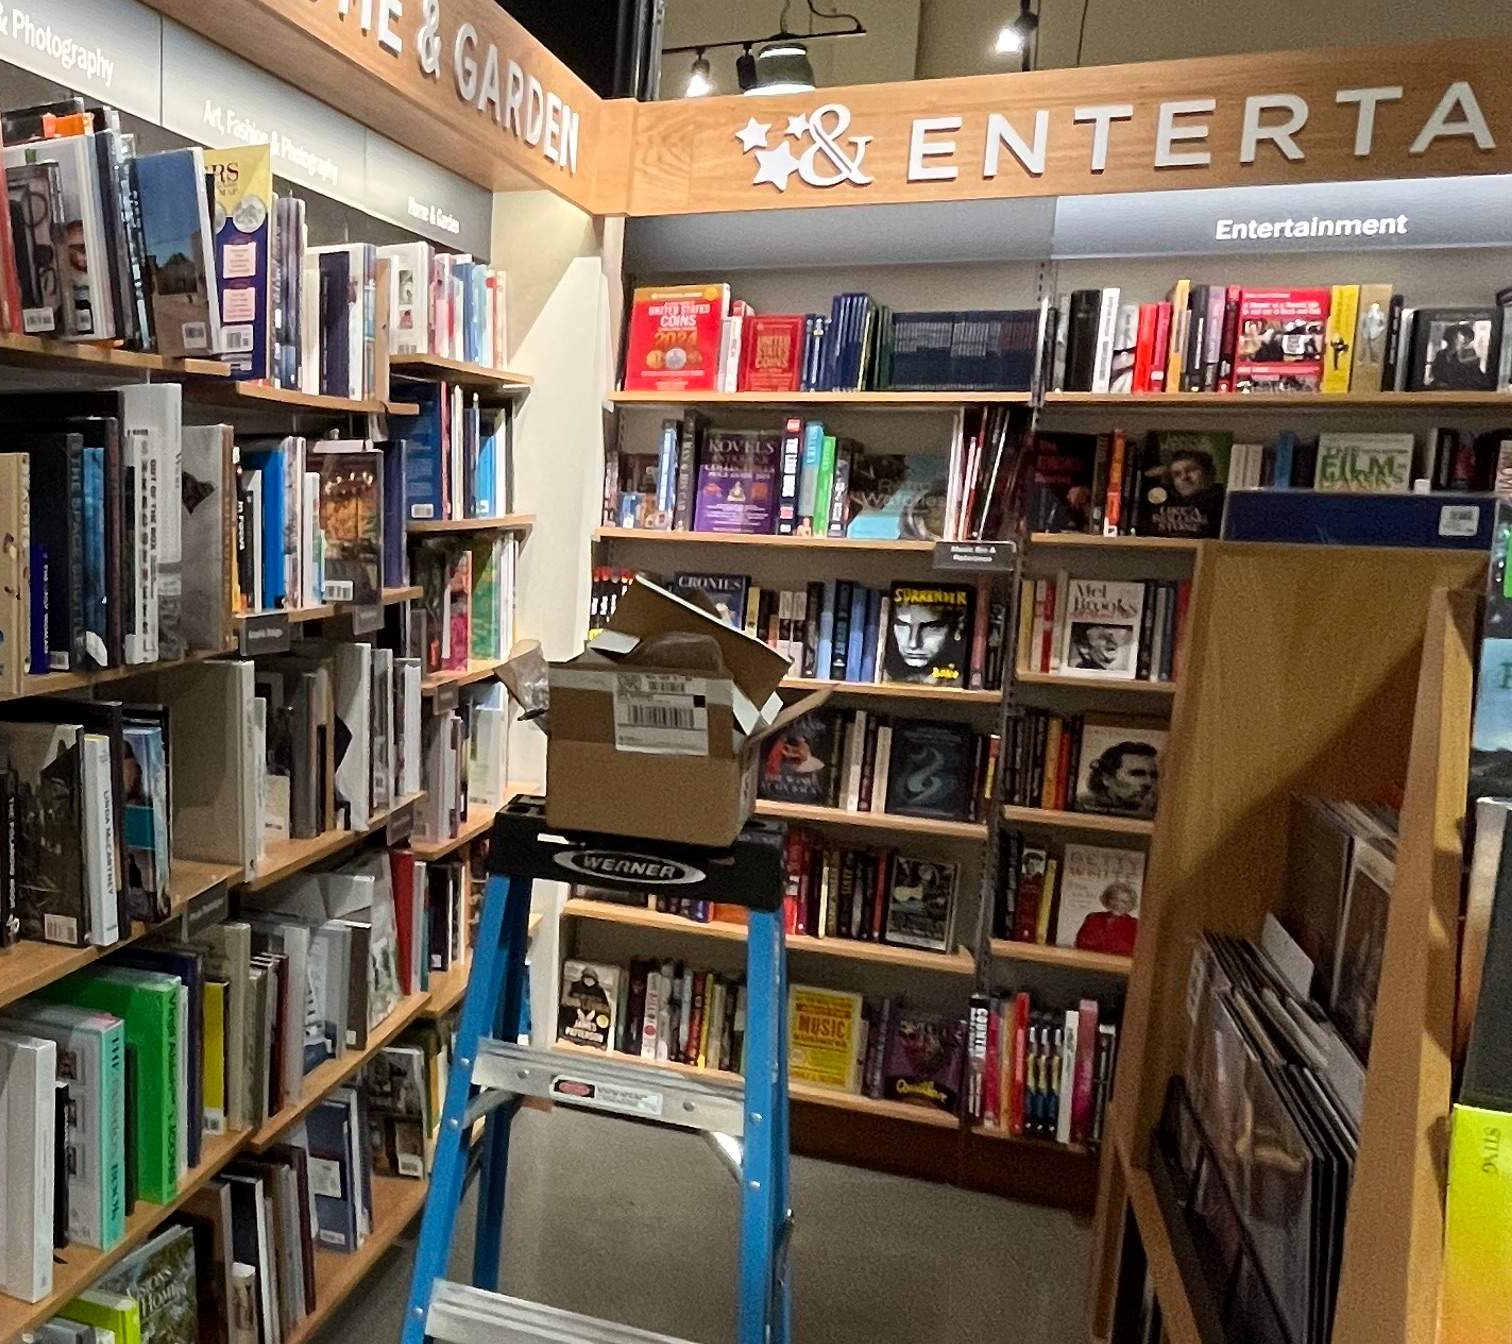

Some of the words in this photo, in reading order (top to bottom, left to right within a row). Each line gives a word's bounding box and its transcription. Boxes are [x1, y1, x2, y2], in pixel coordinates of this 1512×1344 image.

[11, 14, 115, 87] Photography
[453, 23, 579, 175] GARDEN
[907, 80, 1496, 182] ENTERTA
[1214, 212, 1410, 243] Entertainment
[659, 315, 697, 328] COINS
[680, 303, 711, 315] STATES
[893, 587, 968, 606] SURRENDER
[582, 855, 678, 880] WERNER
[797, 1012, 847, 1038] MUSIC
